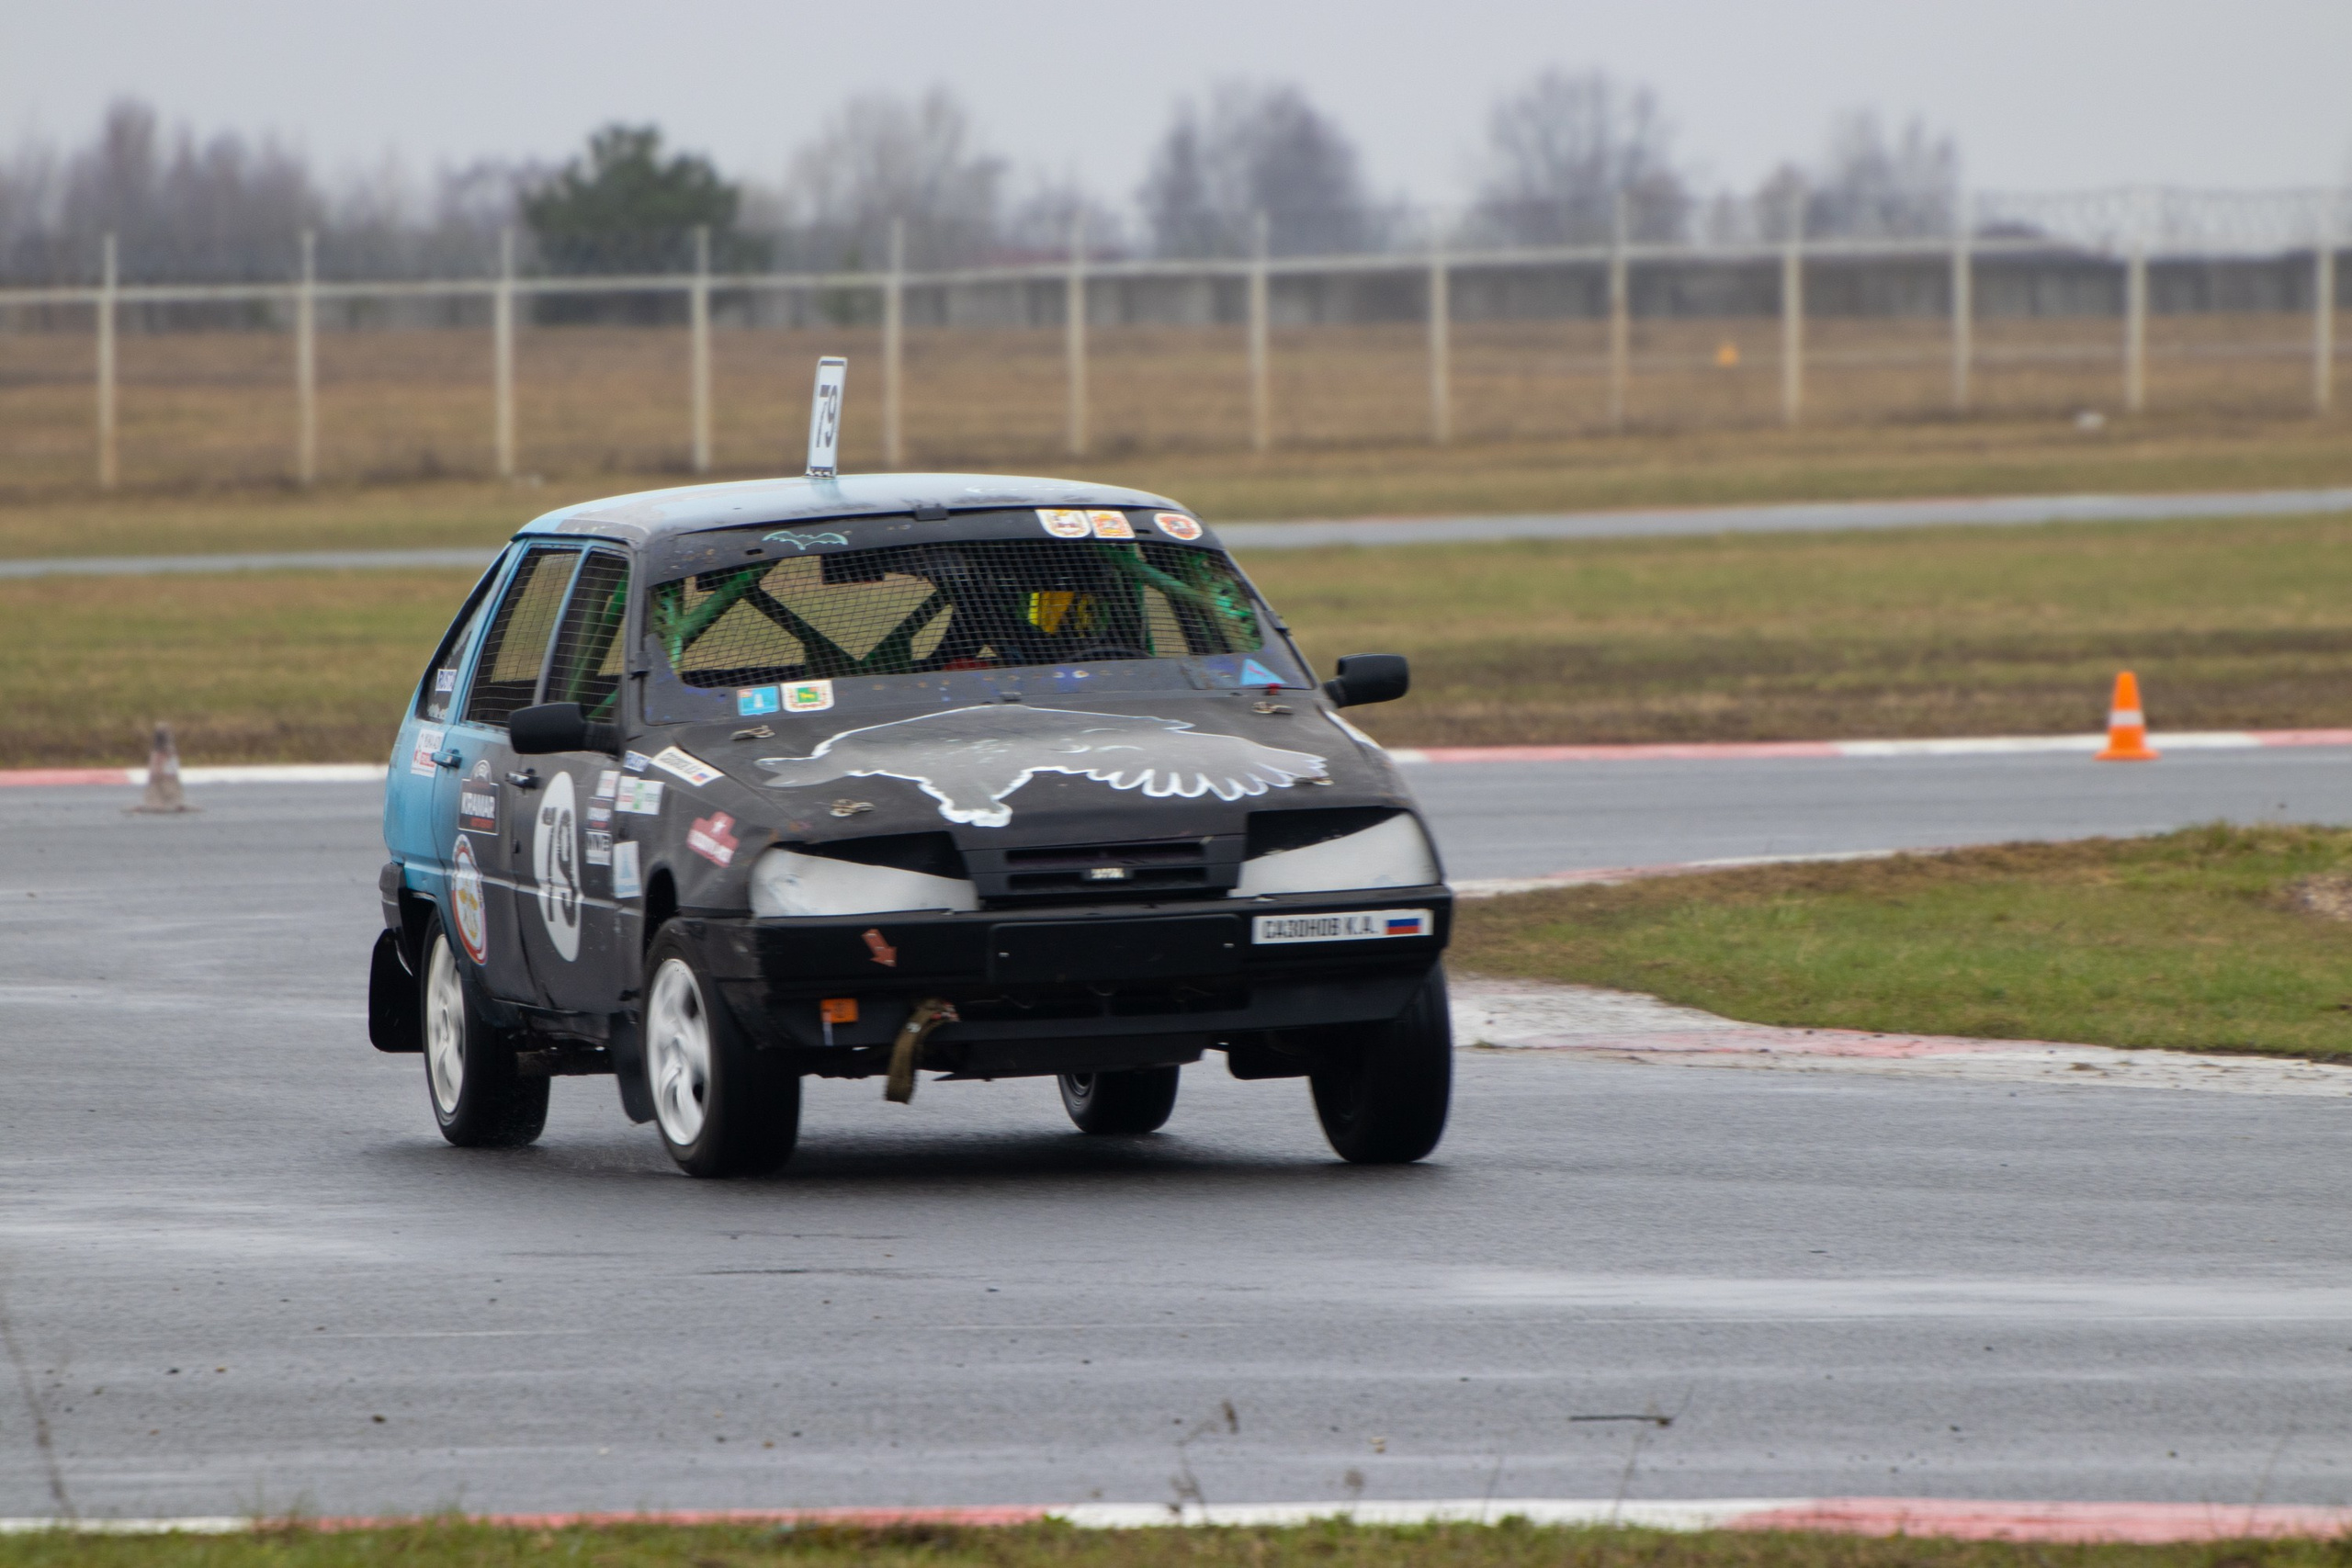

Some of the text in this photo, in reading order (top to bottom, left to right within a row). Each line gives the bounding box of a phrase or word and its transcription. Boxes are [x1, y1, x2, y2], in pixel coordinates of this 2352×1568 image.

[816, 384, 838, 448] 79
[542, 807, 576, 928] 79
[1262, 918, 1340, 939] САЗОНОВ
